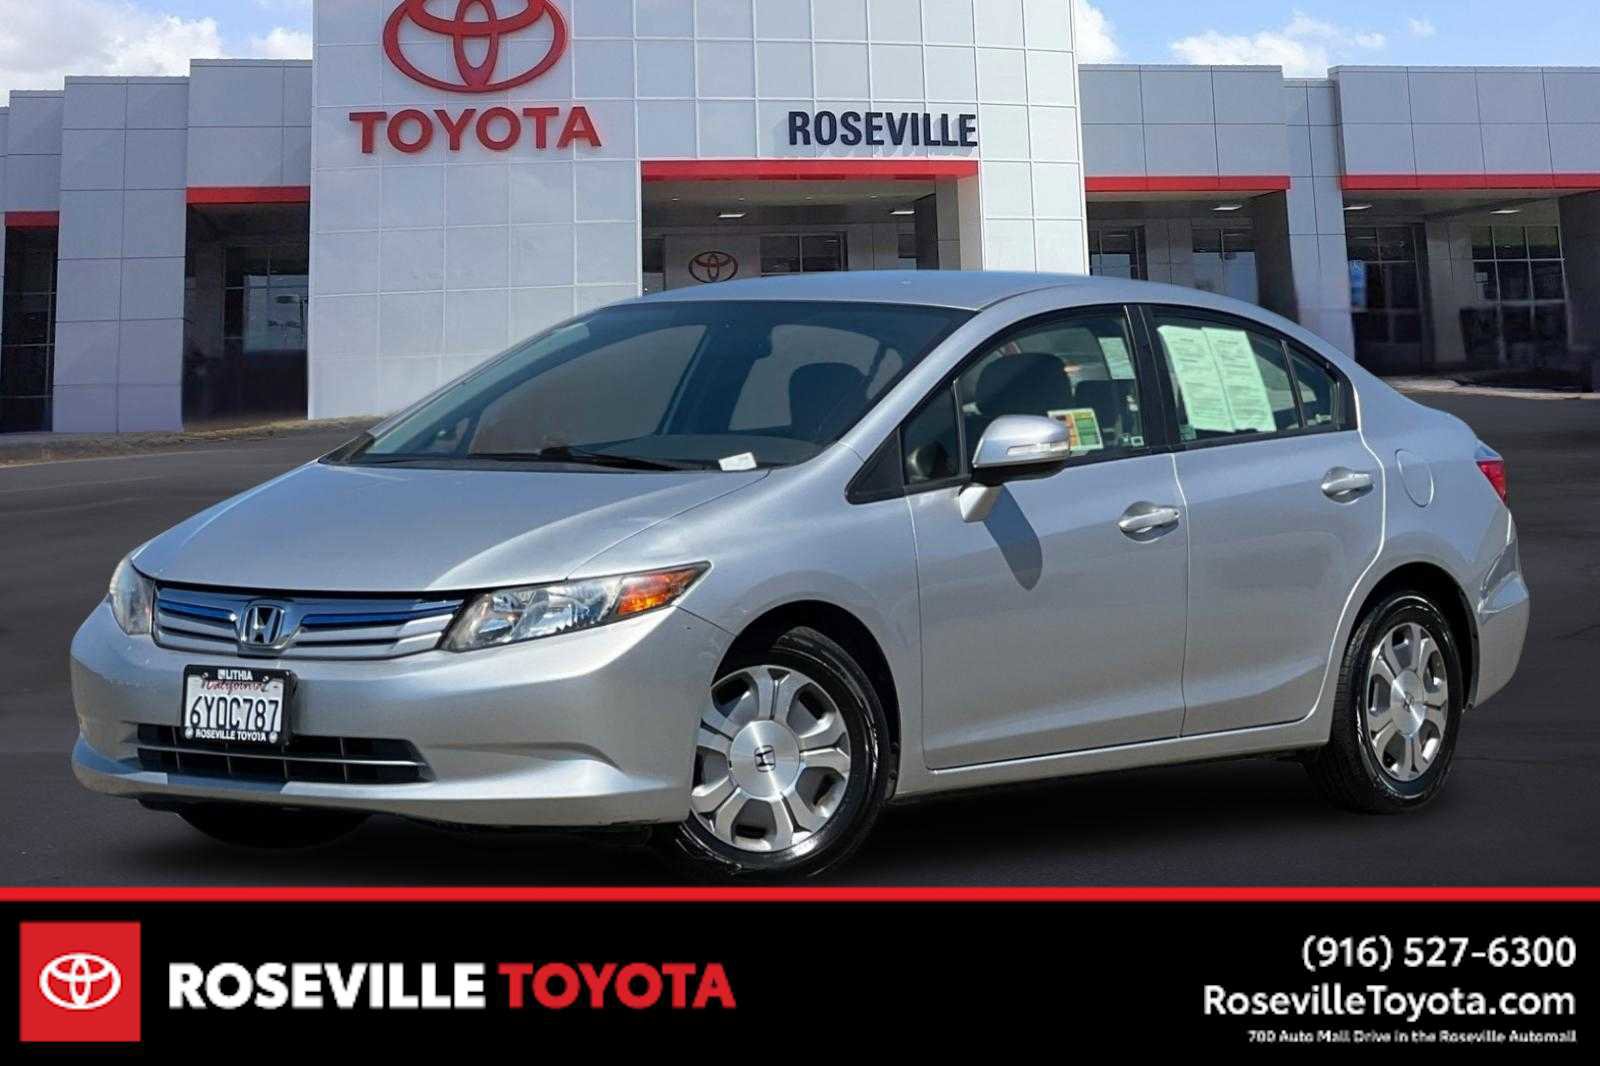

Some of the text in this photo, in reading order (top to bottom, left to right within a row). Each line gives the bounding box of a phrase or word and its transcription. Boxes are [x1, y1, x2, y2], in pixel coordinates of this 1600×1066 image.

[349, 106, 602, 154] TOYOTA
[788, 110, 978, 147] ROSEVILLE
[226, 670, 253, 681] LITHIA
[195, 728, 267, 742] ROSEVILLE TOYOTA
